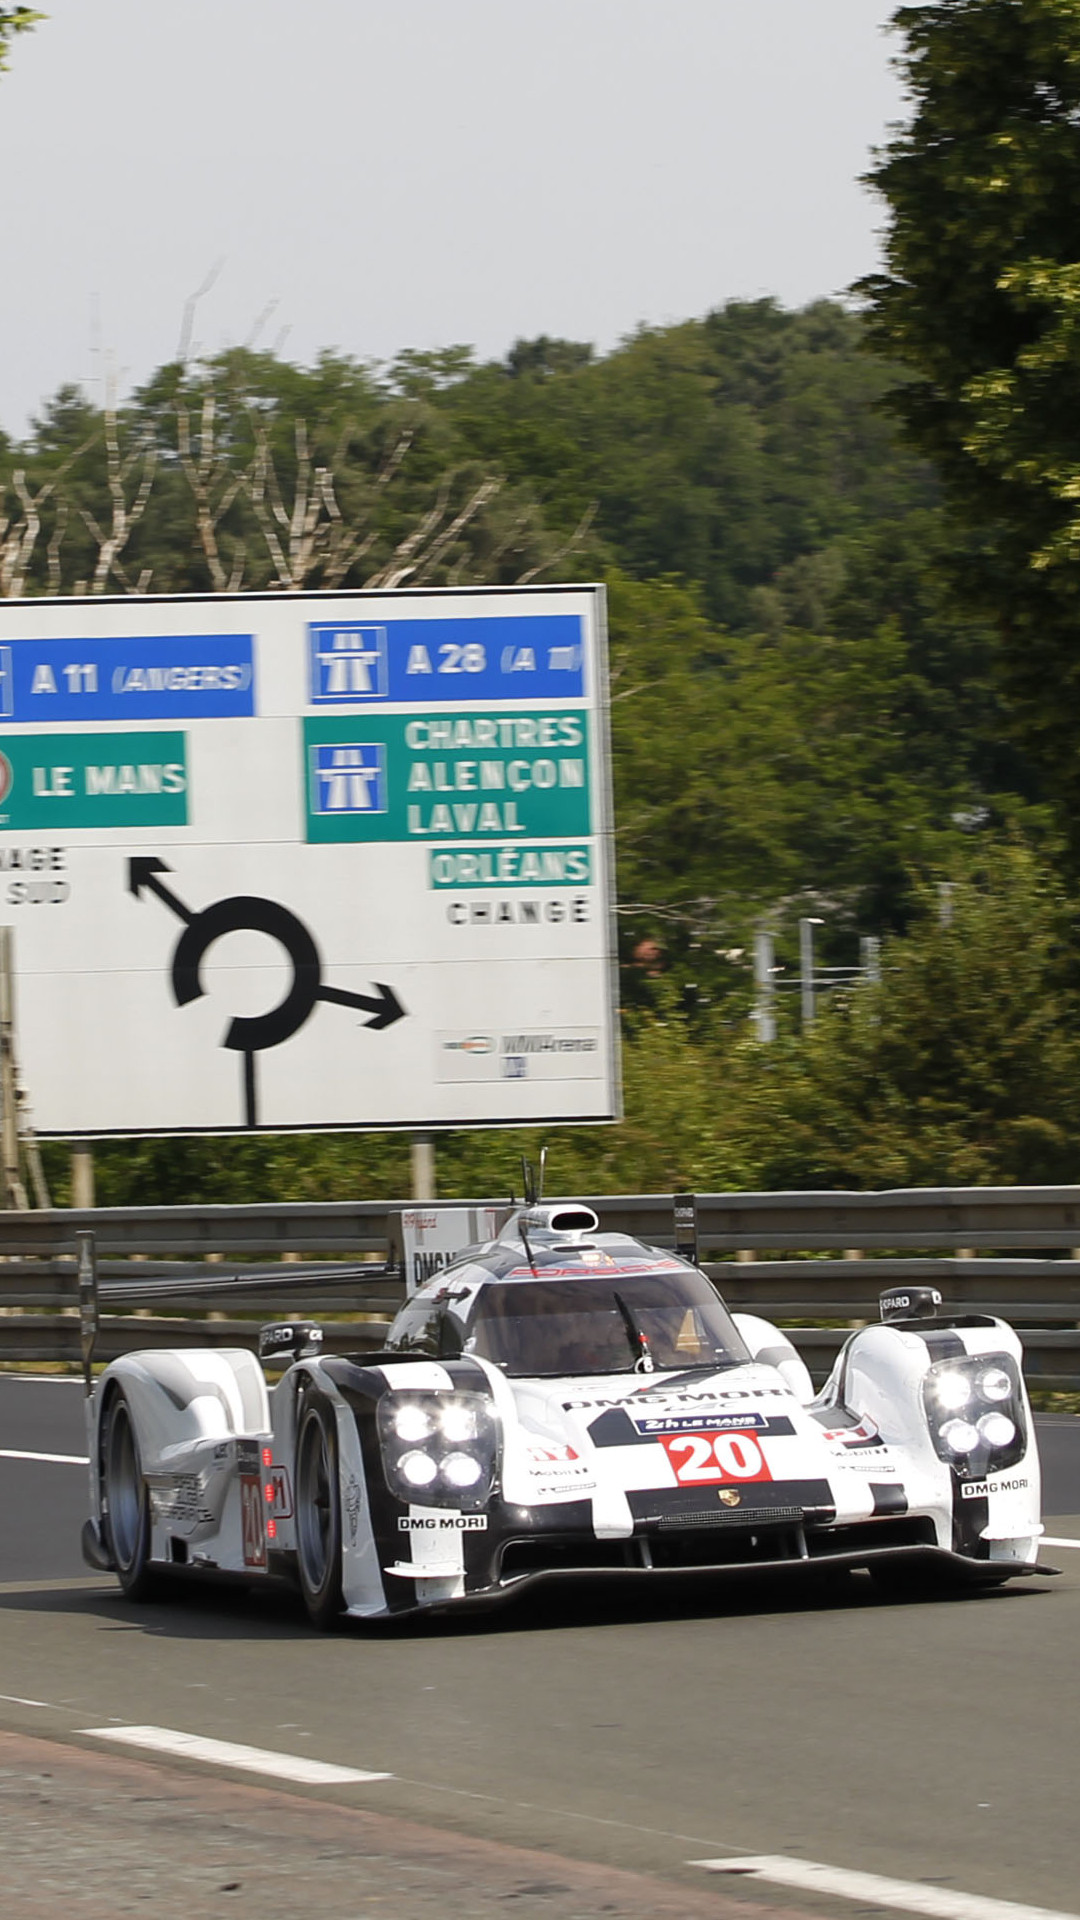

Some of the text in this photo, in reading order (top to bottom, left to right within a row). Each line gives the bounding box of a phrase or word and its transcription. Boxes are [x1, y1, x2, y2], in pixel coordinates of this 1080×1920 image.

[406, 644, 433, 675] A
[438, 643, 486, 673] 28
[31, 663, 251, 694] A 11 (ANGERS)
[405, 717, 584, 749] CHARTRES
[32, 764, 185, 796] LE MANS
[407, 758, 584, 792] ALENÇON
[407, 802, 527, 834] LAVAL
[432, 848, 590, 883] ORLÉANS
[446, 895, 591, 925] CHANGÉ
[561, 1388, 795, 1412] DMG MORI
[669, 1433, 763, 1482] 20
[964, 1479, 1028, 1495] DMG MORI
[400, 1517, 484, 1529] DMG MORI
